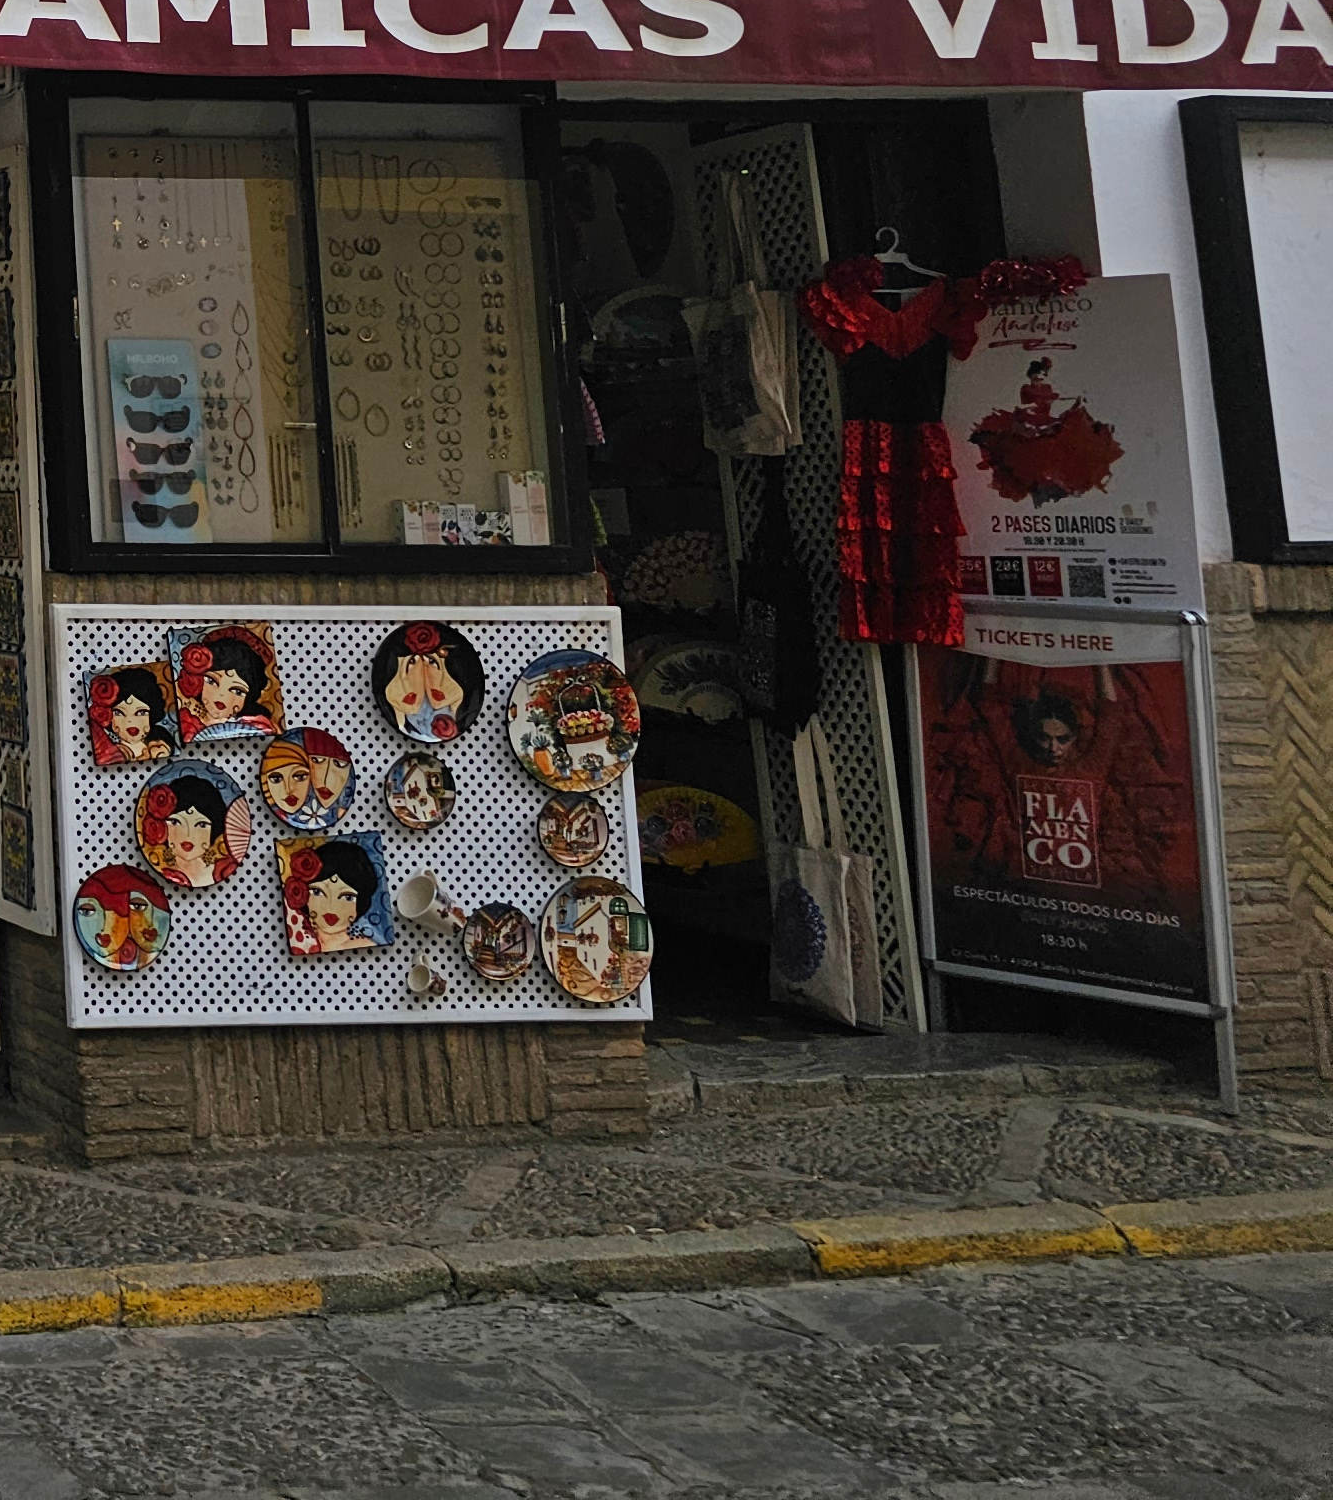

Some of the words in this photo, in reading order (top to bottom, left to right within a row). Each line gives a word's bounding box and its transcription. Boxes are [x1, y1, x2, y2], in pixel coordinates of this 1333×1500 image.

[991, 515, 1001, 533] 2
[1005, 515, 1052, 533] PASES
[1054, 515, 1117, 535] DIARIOS
[975, 627, 1056, 649] TICKETS
[1060, 633, 1114, 652] HERE
[1022, 791, 1090, 824] FLA
[1025, 819, 1090, 842] MEN
[1026, 837, 1092, 869] CO
[1061, 900, 1110, 918] TODOS
[1113, 907, 1143, 923] LOS
[1040, 933, 1076, 949] 18:30
